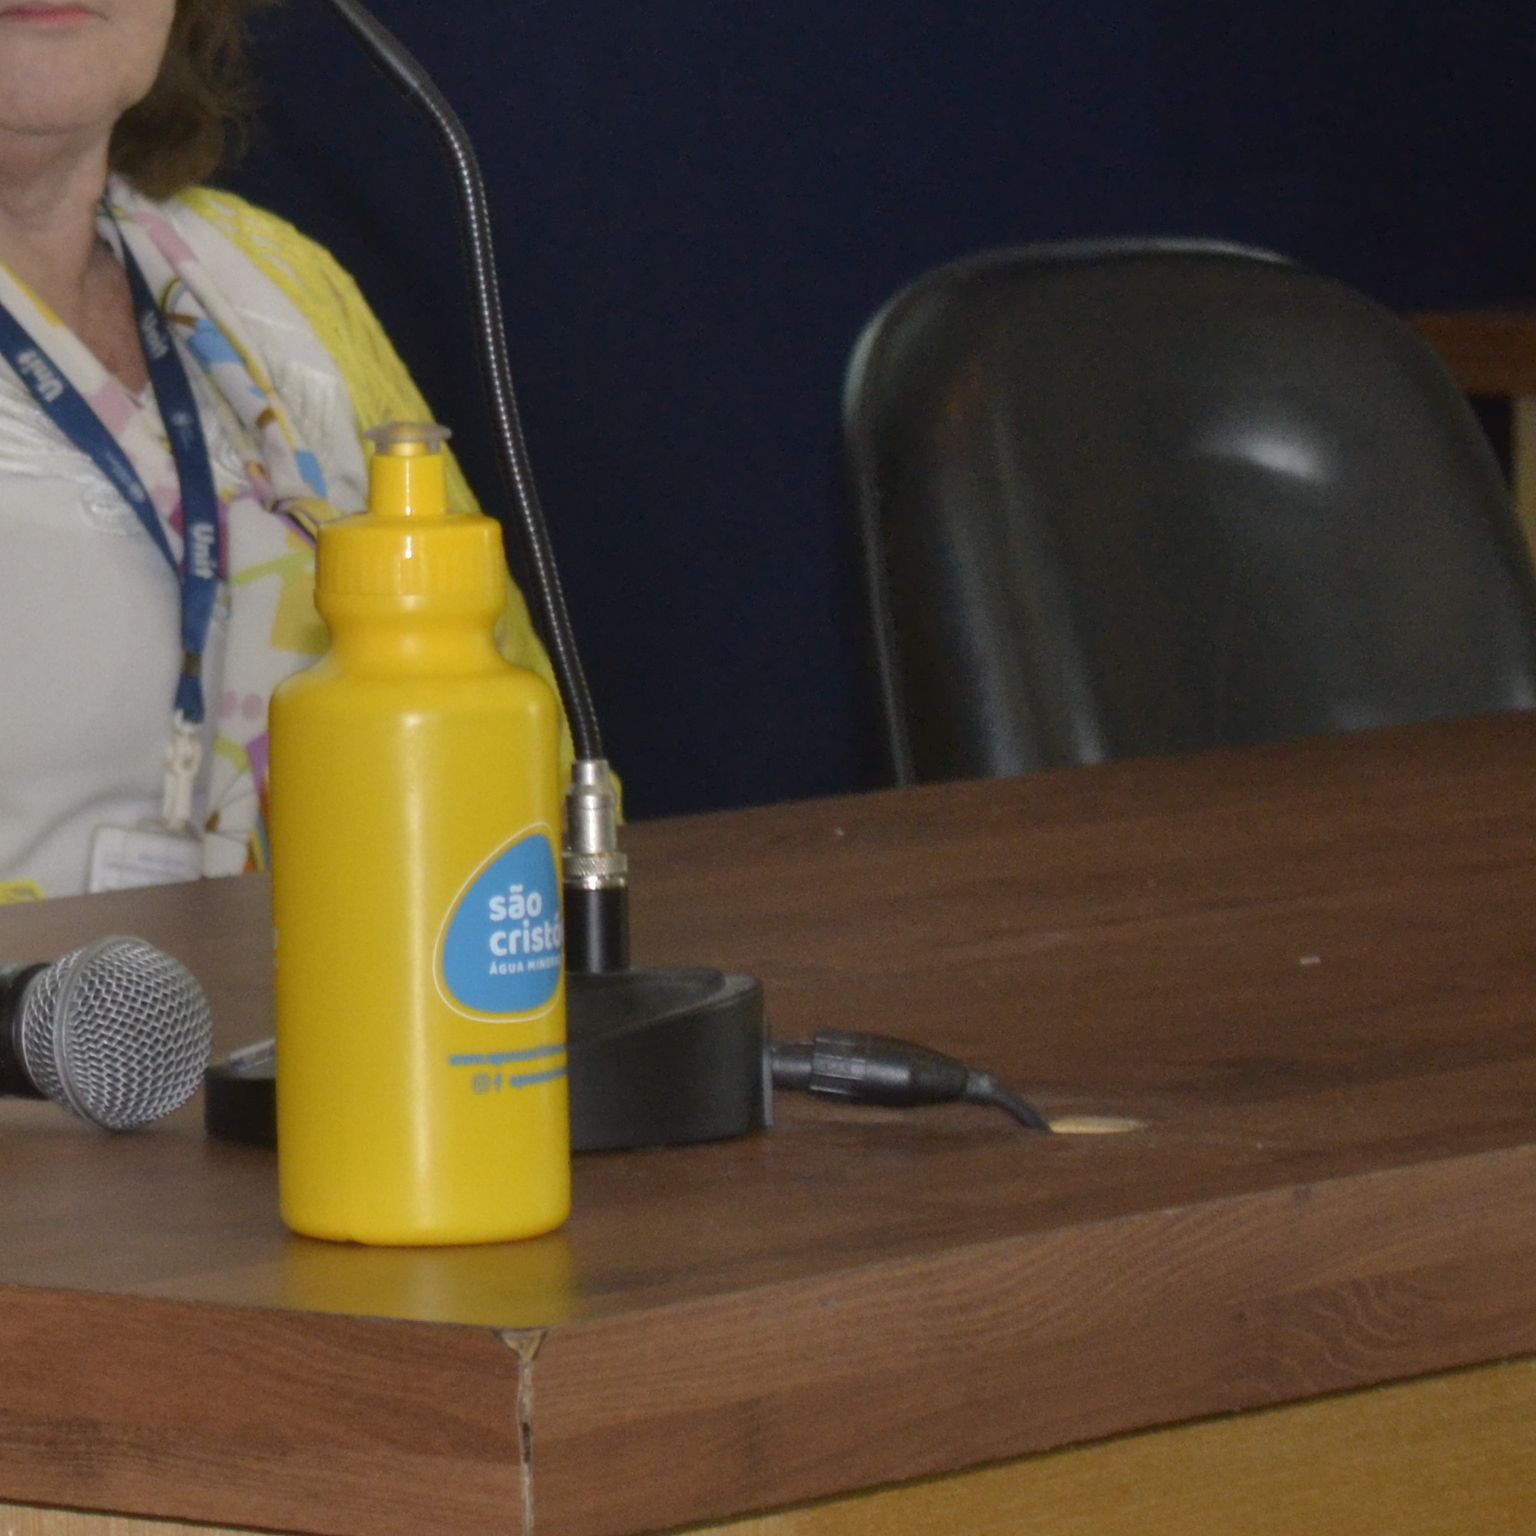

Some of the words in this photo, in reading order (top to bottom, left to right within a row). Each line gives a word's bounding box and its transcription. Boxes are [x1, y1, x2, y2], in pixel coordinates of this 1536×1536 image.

[17, 349, 64, 403] Unit
[192, 523, 216, 579] Unit
[489, 883, 542, 922] são
